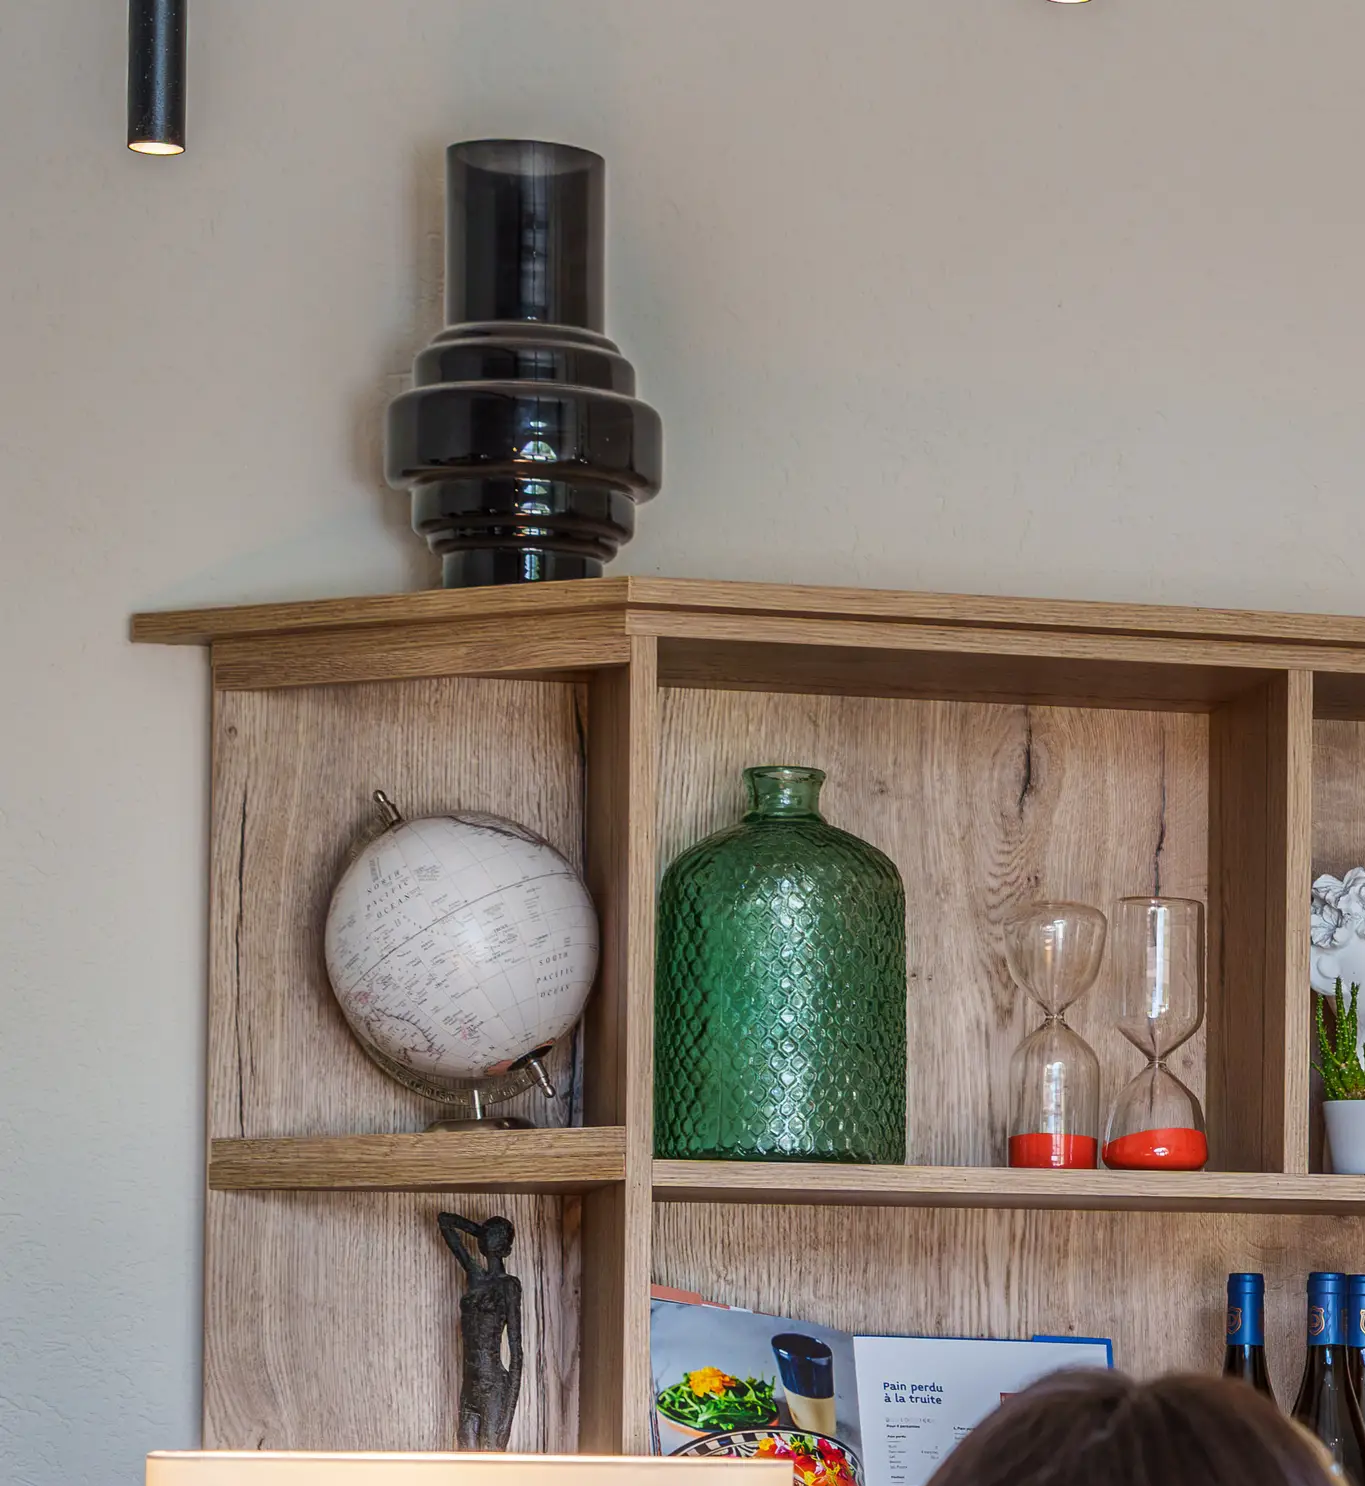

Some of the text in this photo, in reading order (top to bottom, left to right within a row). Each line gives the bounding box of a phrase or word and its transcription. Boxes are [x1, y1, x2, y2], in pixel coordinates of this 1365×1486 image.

[883, 1382, 943, 1395] Pain perdu
[884, 1393, 942, 1405] à la truite
